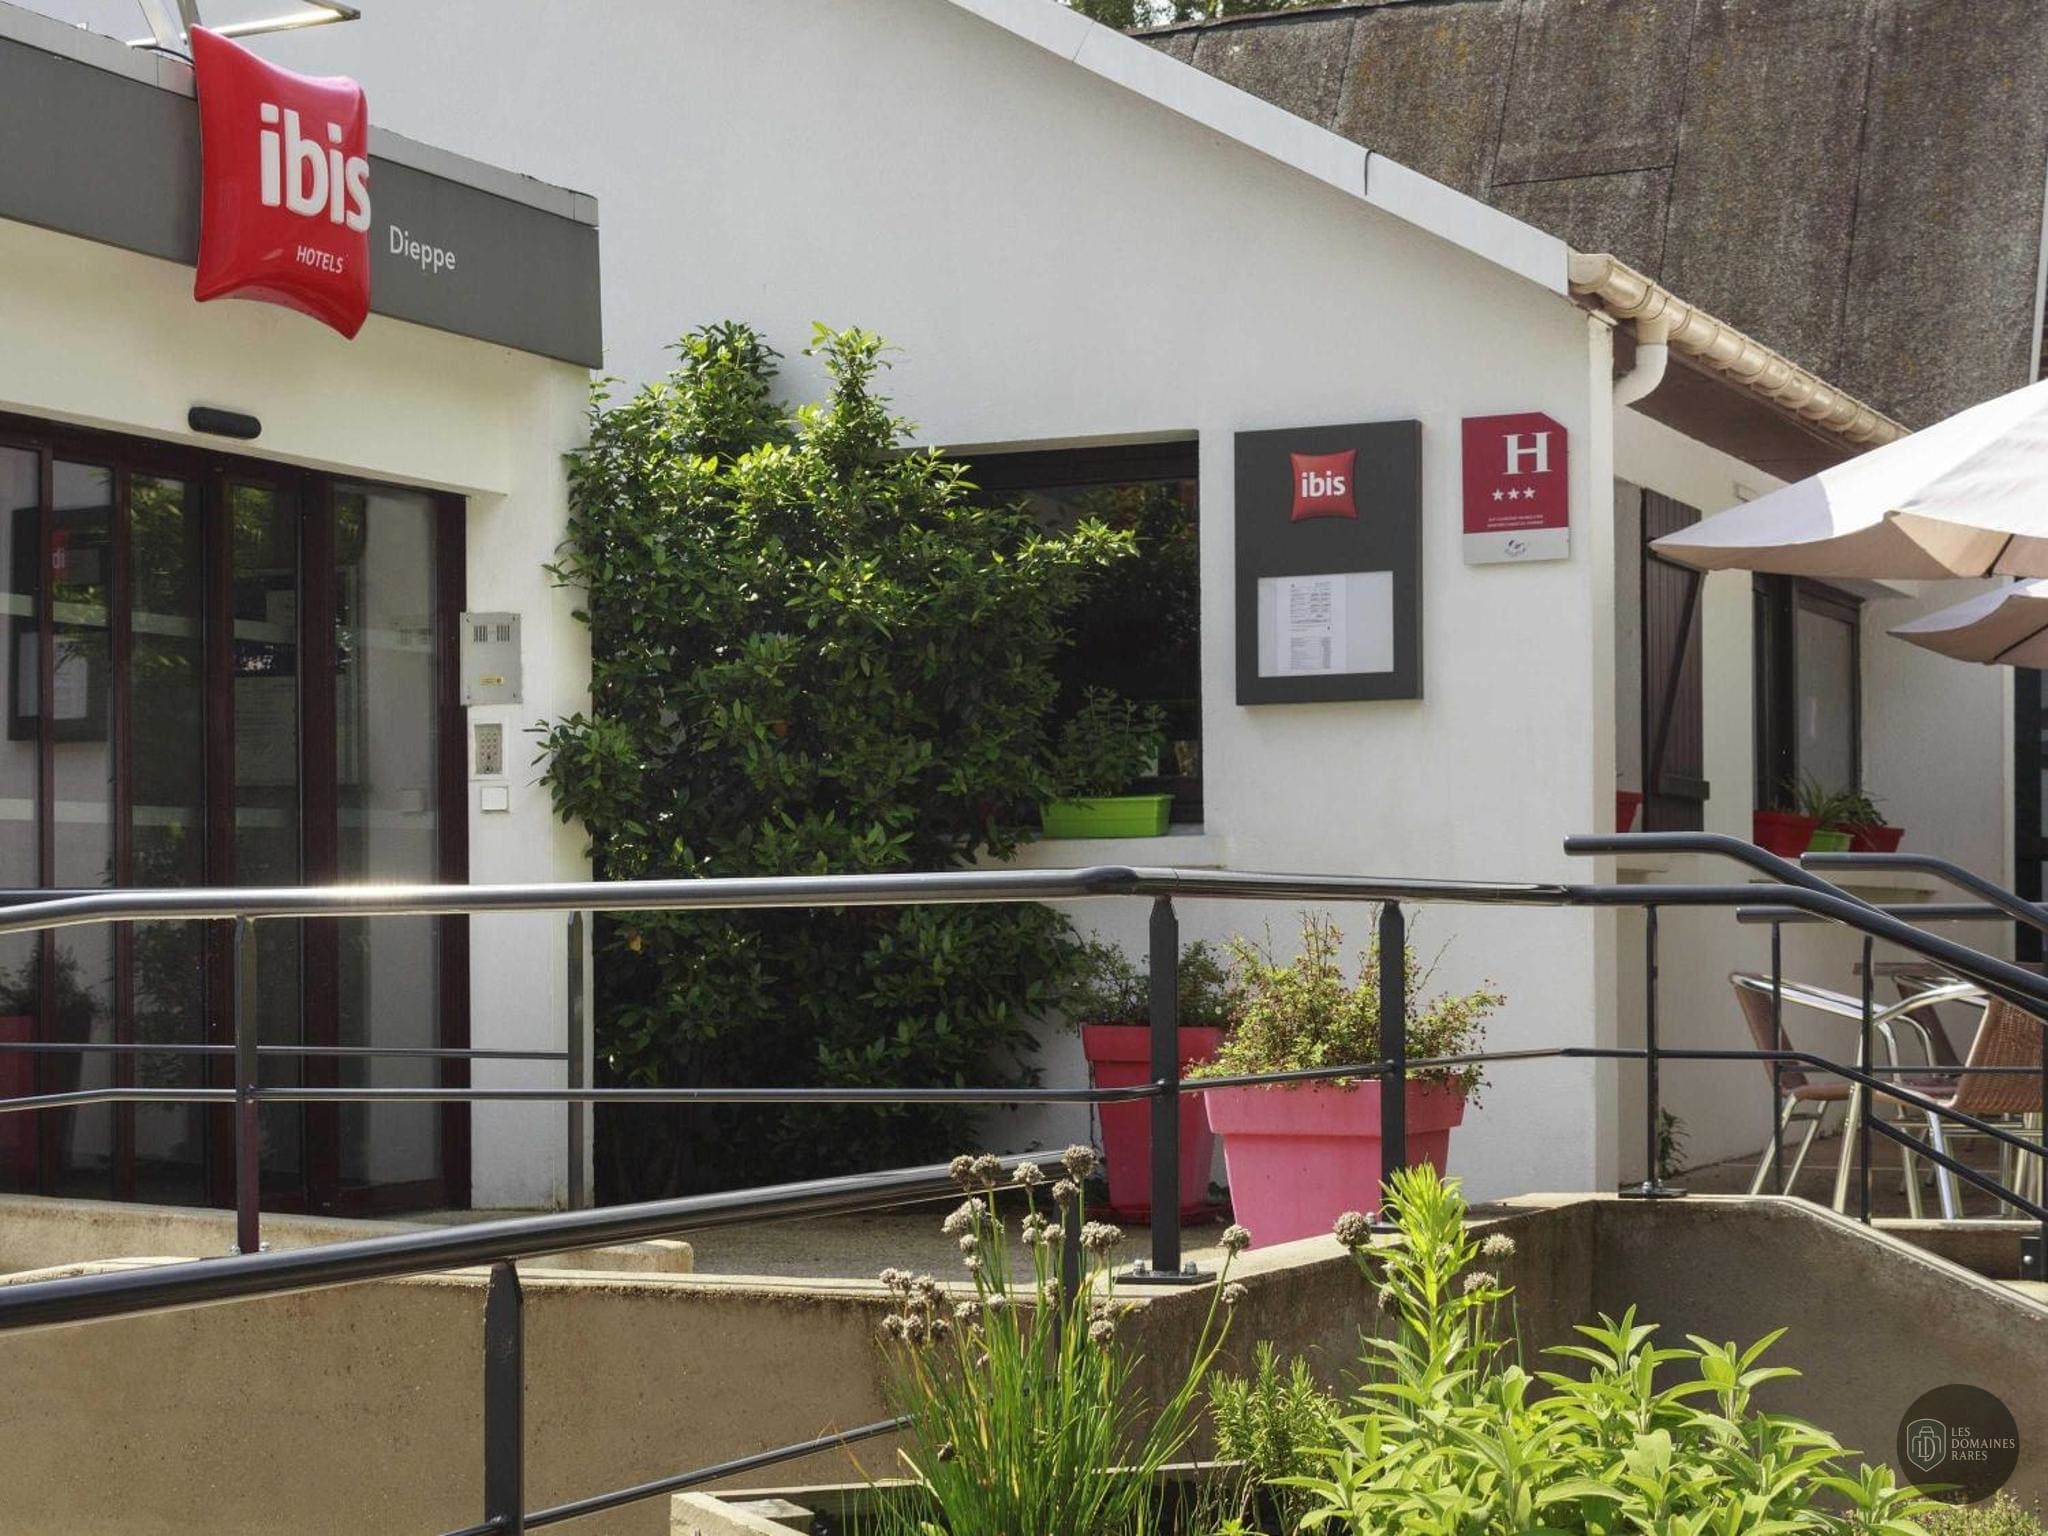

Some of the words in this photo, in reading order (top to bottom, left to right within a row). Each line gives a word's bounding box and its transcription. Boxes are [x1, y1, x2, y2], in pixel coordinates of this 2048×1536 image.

[260, 102, 371, 233] ibis
[296, 245, 344, 274] HOTELS
[389, 225, 457, 273] Dieppe
[1501, 431, 1553, 475] H
[1301, 470, 1346, 498] ibis
